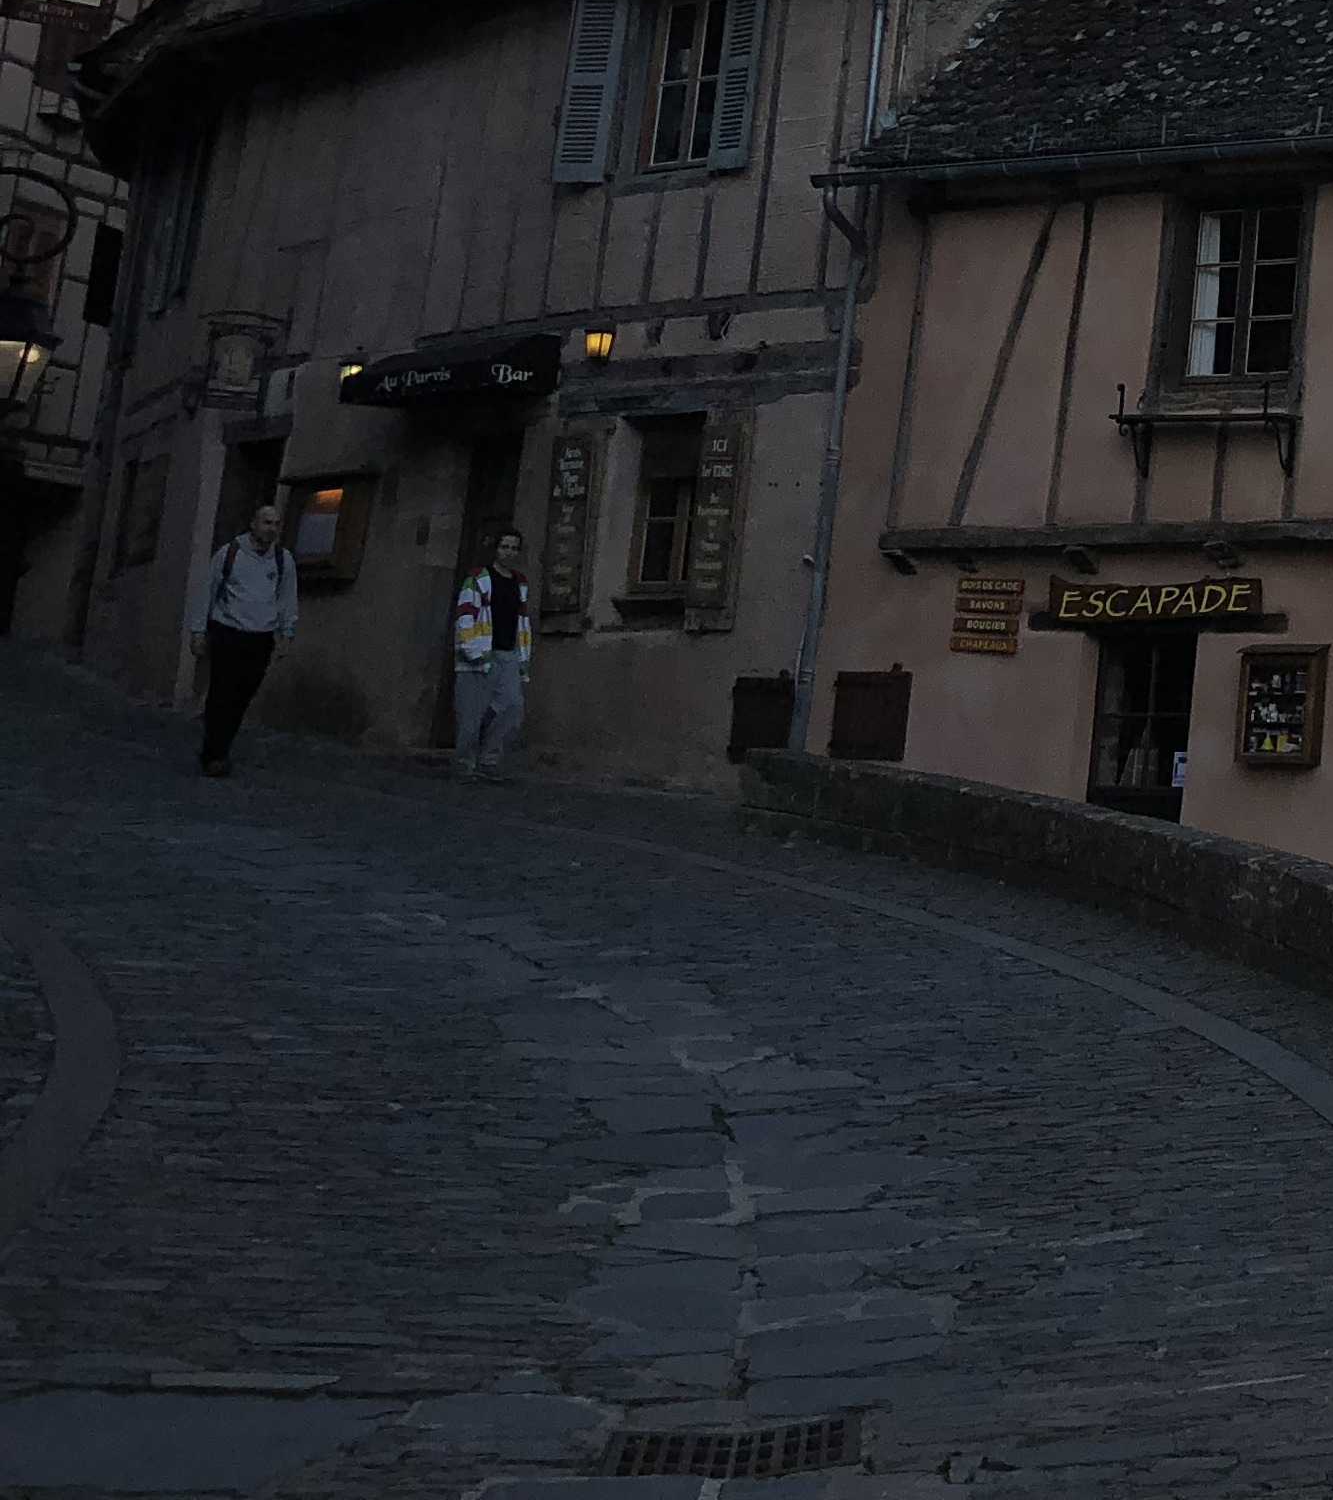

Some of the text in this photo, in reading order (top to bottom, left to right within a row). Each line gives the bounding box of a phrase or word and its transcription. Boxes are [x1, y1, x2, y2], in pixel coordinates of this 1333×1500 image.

[402, 366, 451, 387] Parvis
[491, 363, 534, 384] Bar
[995, 581, 1018, 591] CADE
[970, 600, 1005, 610] SAVONS
[1058, 584, 1252, 618] ESCAPADE
[966, 620, 1006, 630] BOUGIES
